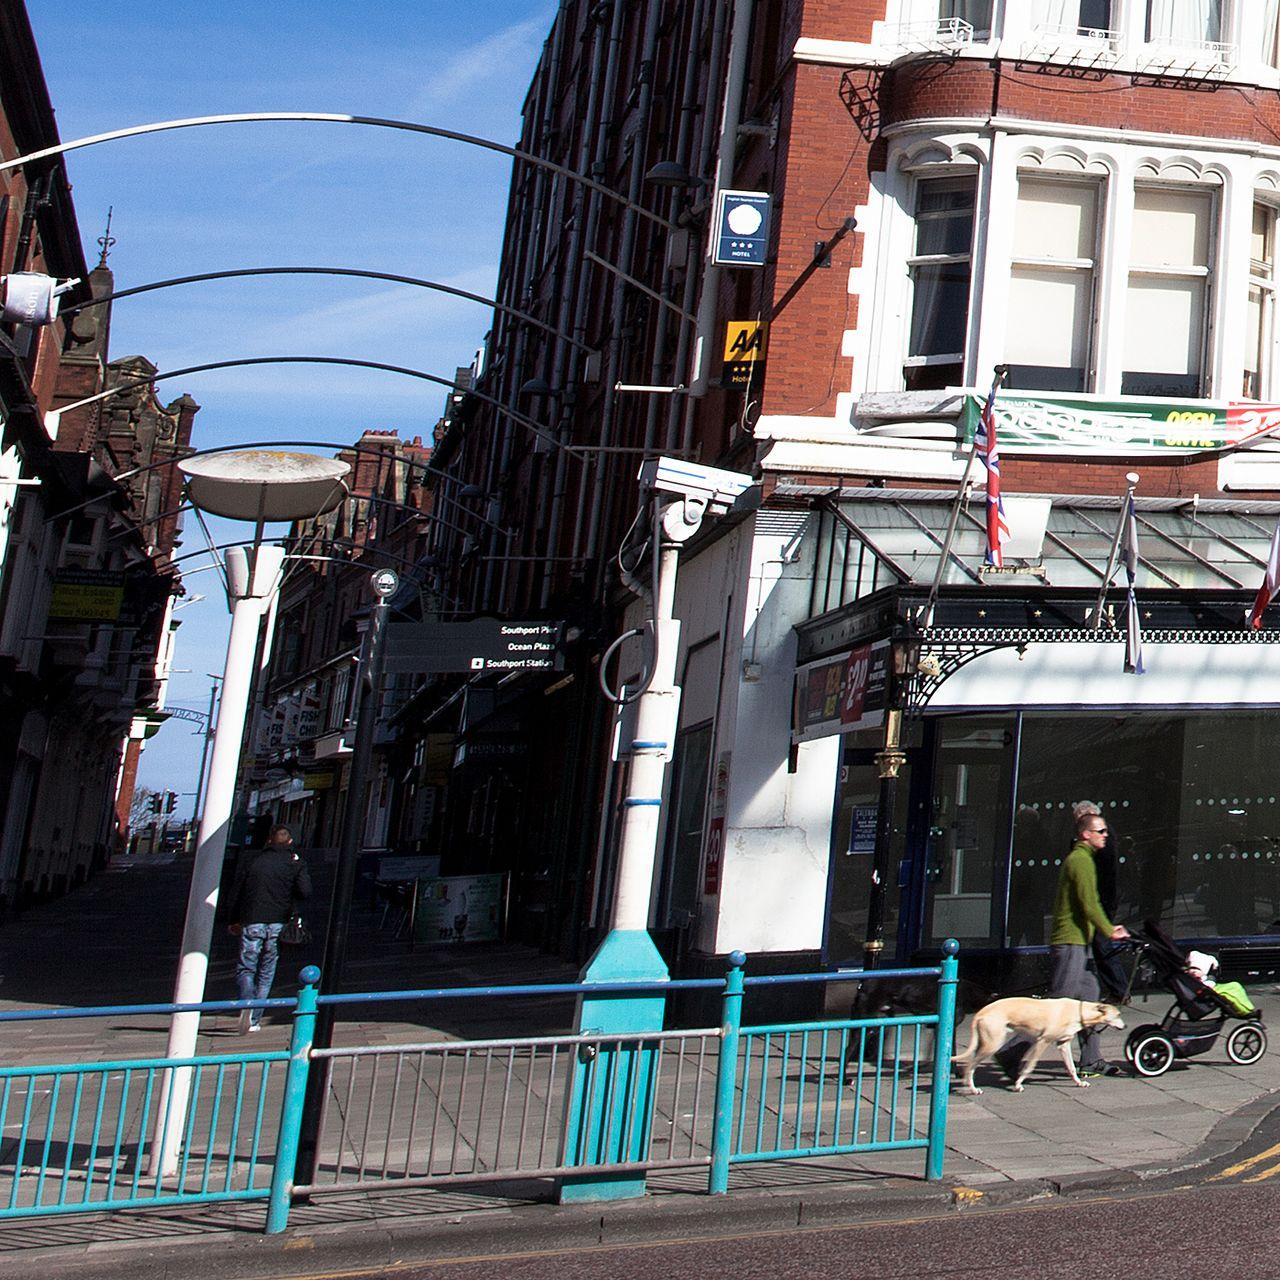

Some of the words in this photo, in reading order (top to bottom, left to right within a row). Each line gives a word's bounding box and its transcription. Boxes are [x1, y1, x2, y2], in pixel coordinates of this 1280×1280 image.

[730, 329, 763, 352] AA
[501, 626, 540, 636] Southport
[508, 642, 533, 651] Ocean
[534, 642, 555, 651] Plaza
[487, 659, 525, 668] Southport
[526, 659, 553, 667] Station
